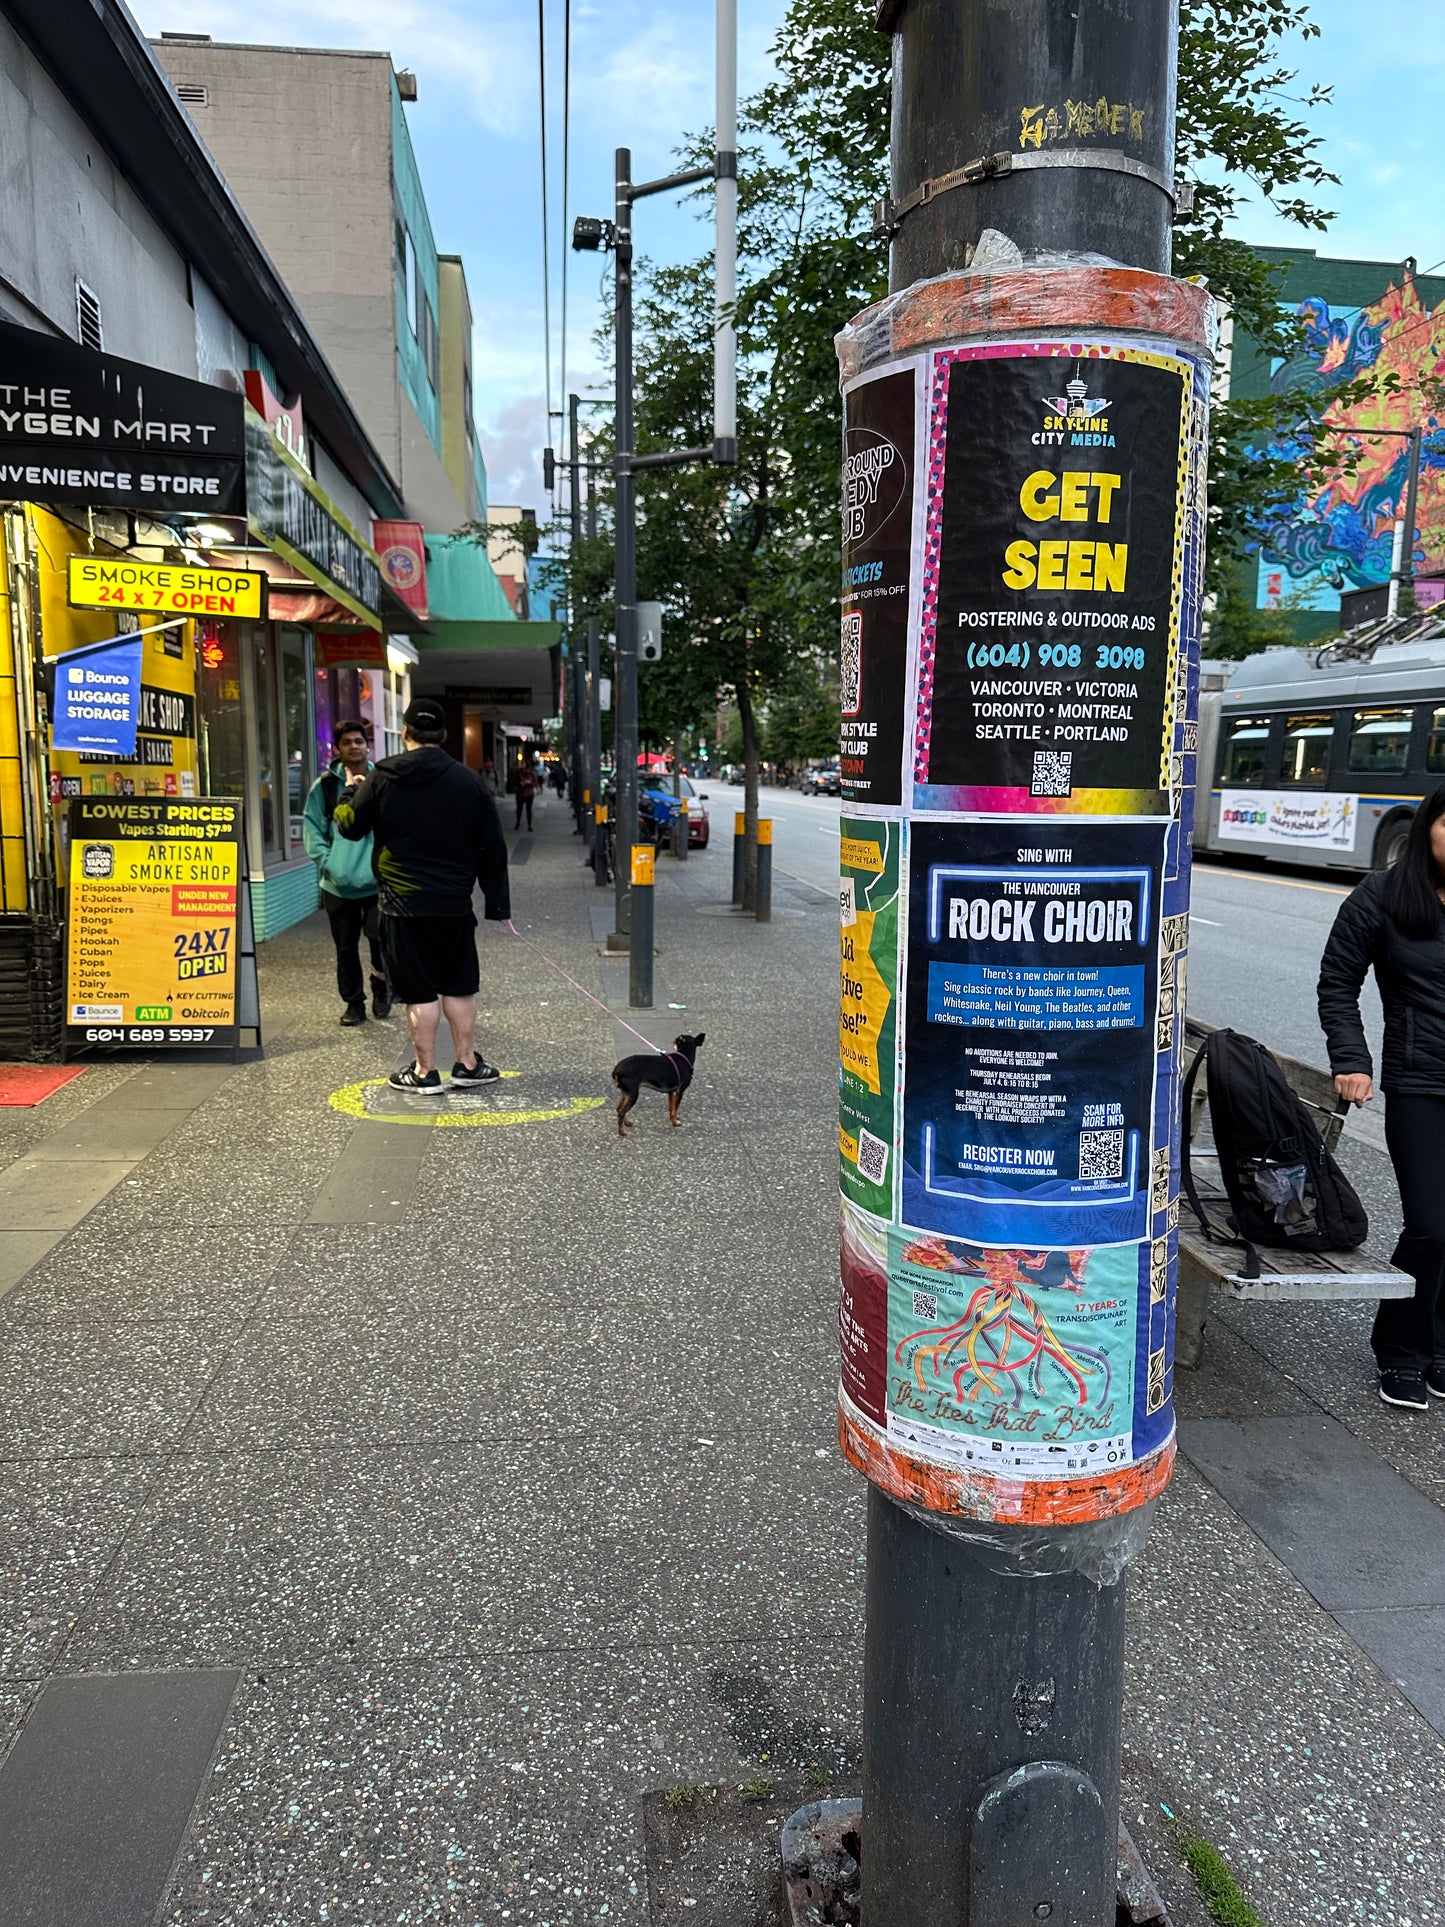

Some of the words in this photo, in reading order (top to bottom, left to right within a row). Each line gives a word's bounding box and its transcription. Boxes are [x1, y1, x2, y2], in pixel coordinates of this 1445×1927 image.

[0, 385, 71, 408] THE
[1043, 416, 1109, 432] SKYLINE
[114, 419, 216, 445] MART
[1031, 432, 1065, 446] CITY
[1070, 433, 1116, 448] MEDIA
[140, 474, 220, 496] STORE
[1019, 469, 1122, 524] GET
[1001, 539, 1128, 593] SEEN
[82, 565, 171, 588] SMOKE
[181, 574, 250, 593] SHOP
[98, 586, 125, 603] 24
[152, 591, 165, 606] 7
[171, 592, 235, 612] OPEN
[860, 590, 873, 599] FOR
[873, 587, 887, 597] 15%
[888, 585, 906, 596] OFF
[958, 611, 1043, 627] POSTERING
[1047, 611, 1058, 627] &
[1061, 612, 1129, 629] OUTDOOR
[1131, 615, 1156, 631] ADS
[967, 641, 1031, 670] (604)
[1038, 643, 1082, 668] 908
[1095, 645, 1145, 670] 3098
[86, 670, 129, 685] Bounce
[970, 680, 1063, 696] VANCOUVER
[1075, 681, 1139, 699] VICTORIA
[67, 690, 130, 705] LUGGAGE
[67, 706, 130, 721] STORAGE
[159, 694, 185, 731] SHOP
[972, 702, 1045, 718] TORONTO
[1057, 703, 1134, 720] MONTREAL
[849, 722, 878, 737] STYLE
[975, 724, 1042, 740] SEATTLE
[1054, 725, 1129, 742] PORTLAND
[147, 741, 174, 763] SNACKS
[848, 741, 869, 755] CLUB
[82, 804, 162, 819] LOWEST
[167, 806, 235, 821] PRICES
[118, 823, 154, 837] Vapes
[157, 824, 204, 839] Starting
[206, 824, 232, 838] $7.99
[147, 845, 213, 861] ARTISAN
[1017, 848, 1043, 863] SING
[1044, 848, 1072, 863] WITH
[863, 857, 879, 865] YEAR!
[130, 864, 183, 880] SMOKE
[190, 865, 231, 881] SHOP
[81, 884, 138, 893] Disposable
[140, 885, 170, 894] Vapes
[178, 891, 207, 900] UNDER
[208, 891, 229, 900] NEW
[1003, 881, 1021, 895] THE
[1023, 882, 1081, 896] VANCOUVER
[81, 894, 123, 903] E-Juices
[840, 888, 851, 909] ed
[81, 905, 134, 914] Vaporizers
[178, 903, 237, 912] MANAGEMENT
[80, 915, 113, 926] Bongs
[949, 897, 1037, 942] ROCK
[1043, 899, 1133, 943] CHOIR
[80, 926, 108, 936] Pipes
[80, 937, 120, 946] Hookah
[173, 927, 231, 958] 24X7
[79, 947, 113, 956] Cuban
[79, 958, 105, 968] Pops
[179, 954, 225, 979] OPEN
[79, 969, 111, 978] Juices
[982, 967, 1013, 980] There's
[1015, 972, 1021, 980] a
[1023, 972, 1040, 981] new
[1043, 971, 1065, 981] choir
[1066, 971, 1075, 981] in
[1077, 970, 1099, 981] town!
[79, 979, 106, 990] Dairy
[944, 981, 961, 994] Sing
[963, 983, 992, 995] classic
[994, 985, 1013, 996] rock
[1016, 986, 1026, 998] by
[1028, 986, 1054, 997] bands
[1056, 986, 1071, 997] like
[1073, 986, 1105, 998] Journey,
[1107, 985, 1131, 997] Queen,
[78, 991, 94, 999] Ice
[96, 991, 130, 999] Cream
[176, 992, 193, 1000] KEY
[195, 992, 234, 1001] CUTTING
[943, 996, 992, 1012] Whitesnake,
[994, 1000, 1012, 1011] Neil
[1014, 1001, 1043, 1015] Young,
[1045, 1002, 1060, 1013] The
[1062, 1002, 1095, 1013] Beatles,
[1097, 1001, 1111, 1012] and
[1112, 1001, 1132, 1011] other
[88, 1007, 119, 1015] Bounce
[139, 1008, 169, 1020] ATM
[191, 1008, 230, 1019] bitcoin
[934, 1012, 970, 1025] rockers...
[971, 1015, 995, 1028] along
[997, 1016, 1016, 1027] with
[1018, 1018, 1047, 1030] guitar,
[1048, 1018, 1074, 1030] piano,
[1075, 1018, 1094, 1028] bass
[1096, 1016, 1110, 1027] and
[1111, 1015, 1136, 1027] drums!
[86, 1029, 124, 1041] 604
[129, 1029, 164, 1041] 689
[168, 1029, 215, 1041] 5937
[965, 1047, 974, 1056] NO
[973, 1048, 1002, 1058] AUDITIONS
[1002, 1050, 1015, 1058] ARE
[1015, 1051, 1037, 1060] NEEDED
[1037, 1052, 1045, 1060] TO
[979, 1056, 1008, 1065] EVERYONE
[1008, 1058, 1015, 1066] IS
[1015, 1058, 1044, 1067] WELCOME!
[855, 1109, 871, 1124] West
[1083, 1104, 1105, 1116] SCAN
[1106, 1103, 1122, 1115] FOR
[1081, 1115, 1106, 1127] MORE
[1106, 1114, 1124, 1126] INFO
[963, 1143, 1022, 1165] REGISTER
[1025, 1149, 1055, 1166] NOW
[891, 1273, 964, 1298] queerartsfestival.com
[909, 1272, 922, 1280] MORE
[922, 1275, 954, 1287] INFORMATION
[1075, 1304, 1086, 1312] 17
[1088, 1300, 1118, 1312] YEARS
[1118, 1299, 1128, 1307] OF
[1056, 1309, 1128, 1323] TRANSDISCIPLINARY
[1114, 1319, 1128, 1328] ART
[851, 1319, 866, 1339] THE
[850, 1331, 869, 1354] ARTS
[950, 1357, 969, 1367] Music
[1075, 1354, 1095, 1366] Media
[1095, 1363, 1105, 1374] Arts
[963, 1376, 979, 1392] Dance
[1026, 1360, 1040, 1400] Performance
[1049, 1361, 1069, 1379] Spoken
[1066, 1378, 1078, 1395] Word
[891, 1376, 928, 1413] The
[928, 1390, 978, 1425] Ties
[982, 1401, 1047, 1432] That
[1042, 1403, 1114, 1441] Bind
